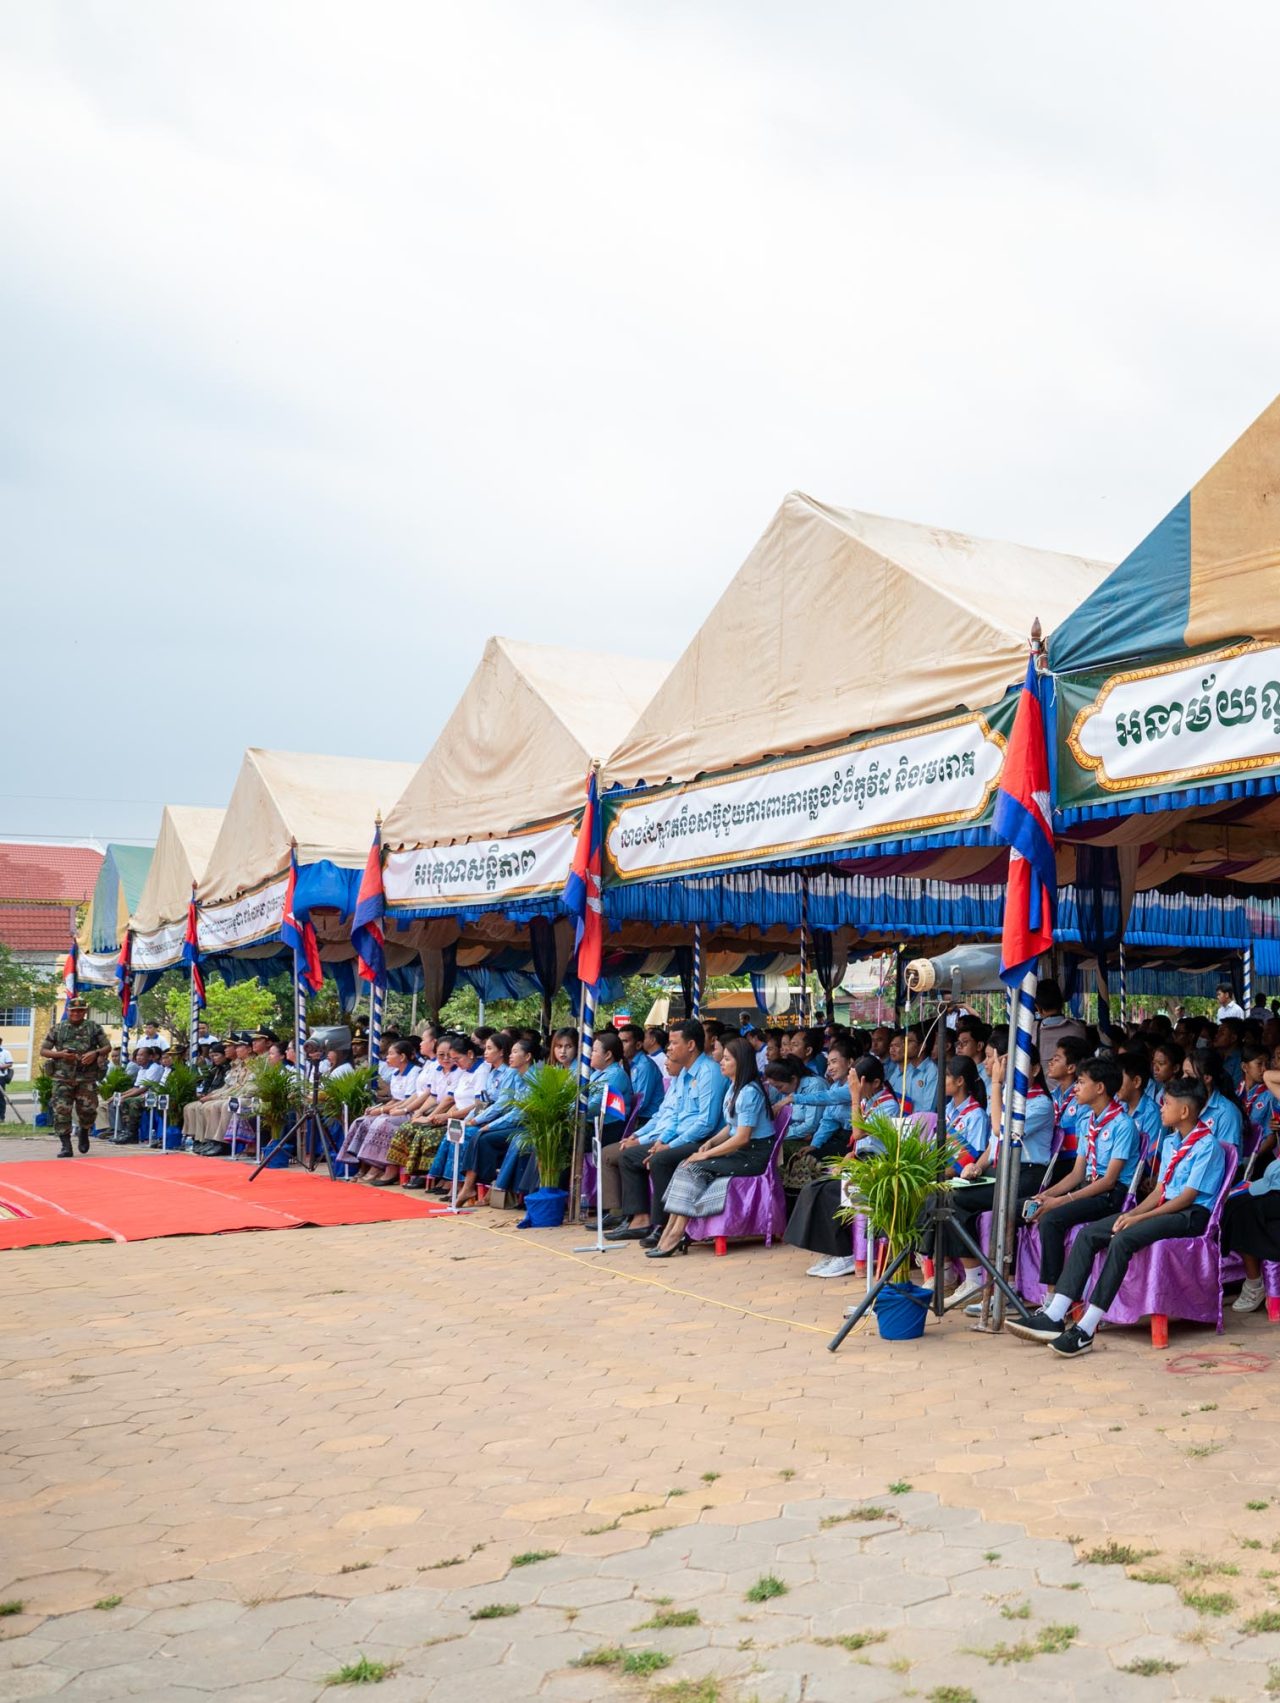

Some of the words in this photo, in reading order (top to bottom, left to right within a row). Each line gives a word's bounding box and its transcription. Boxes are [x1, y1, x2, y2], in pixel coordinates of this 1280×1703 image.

[895, 751, 975, 792] និងមេរោគ
[415, 844, 536, 893] អរគុណសន្តិភាព
